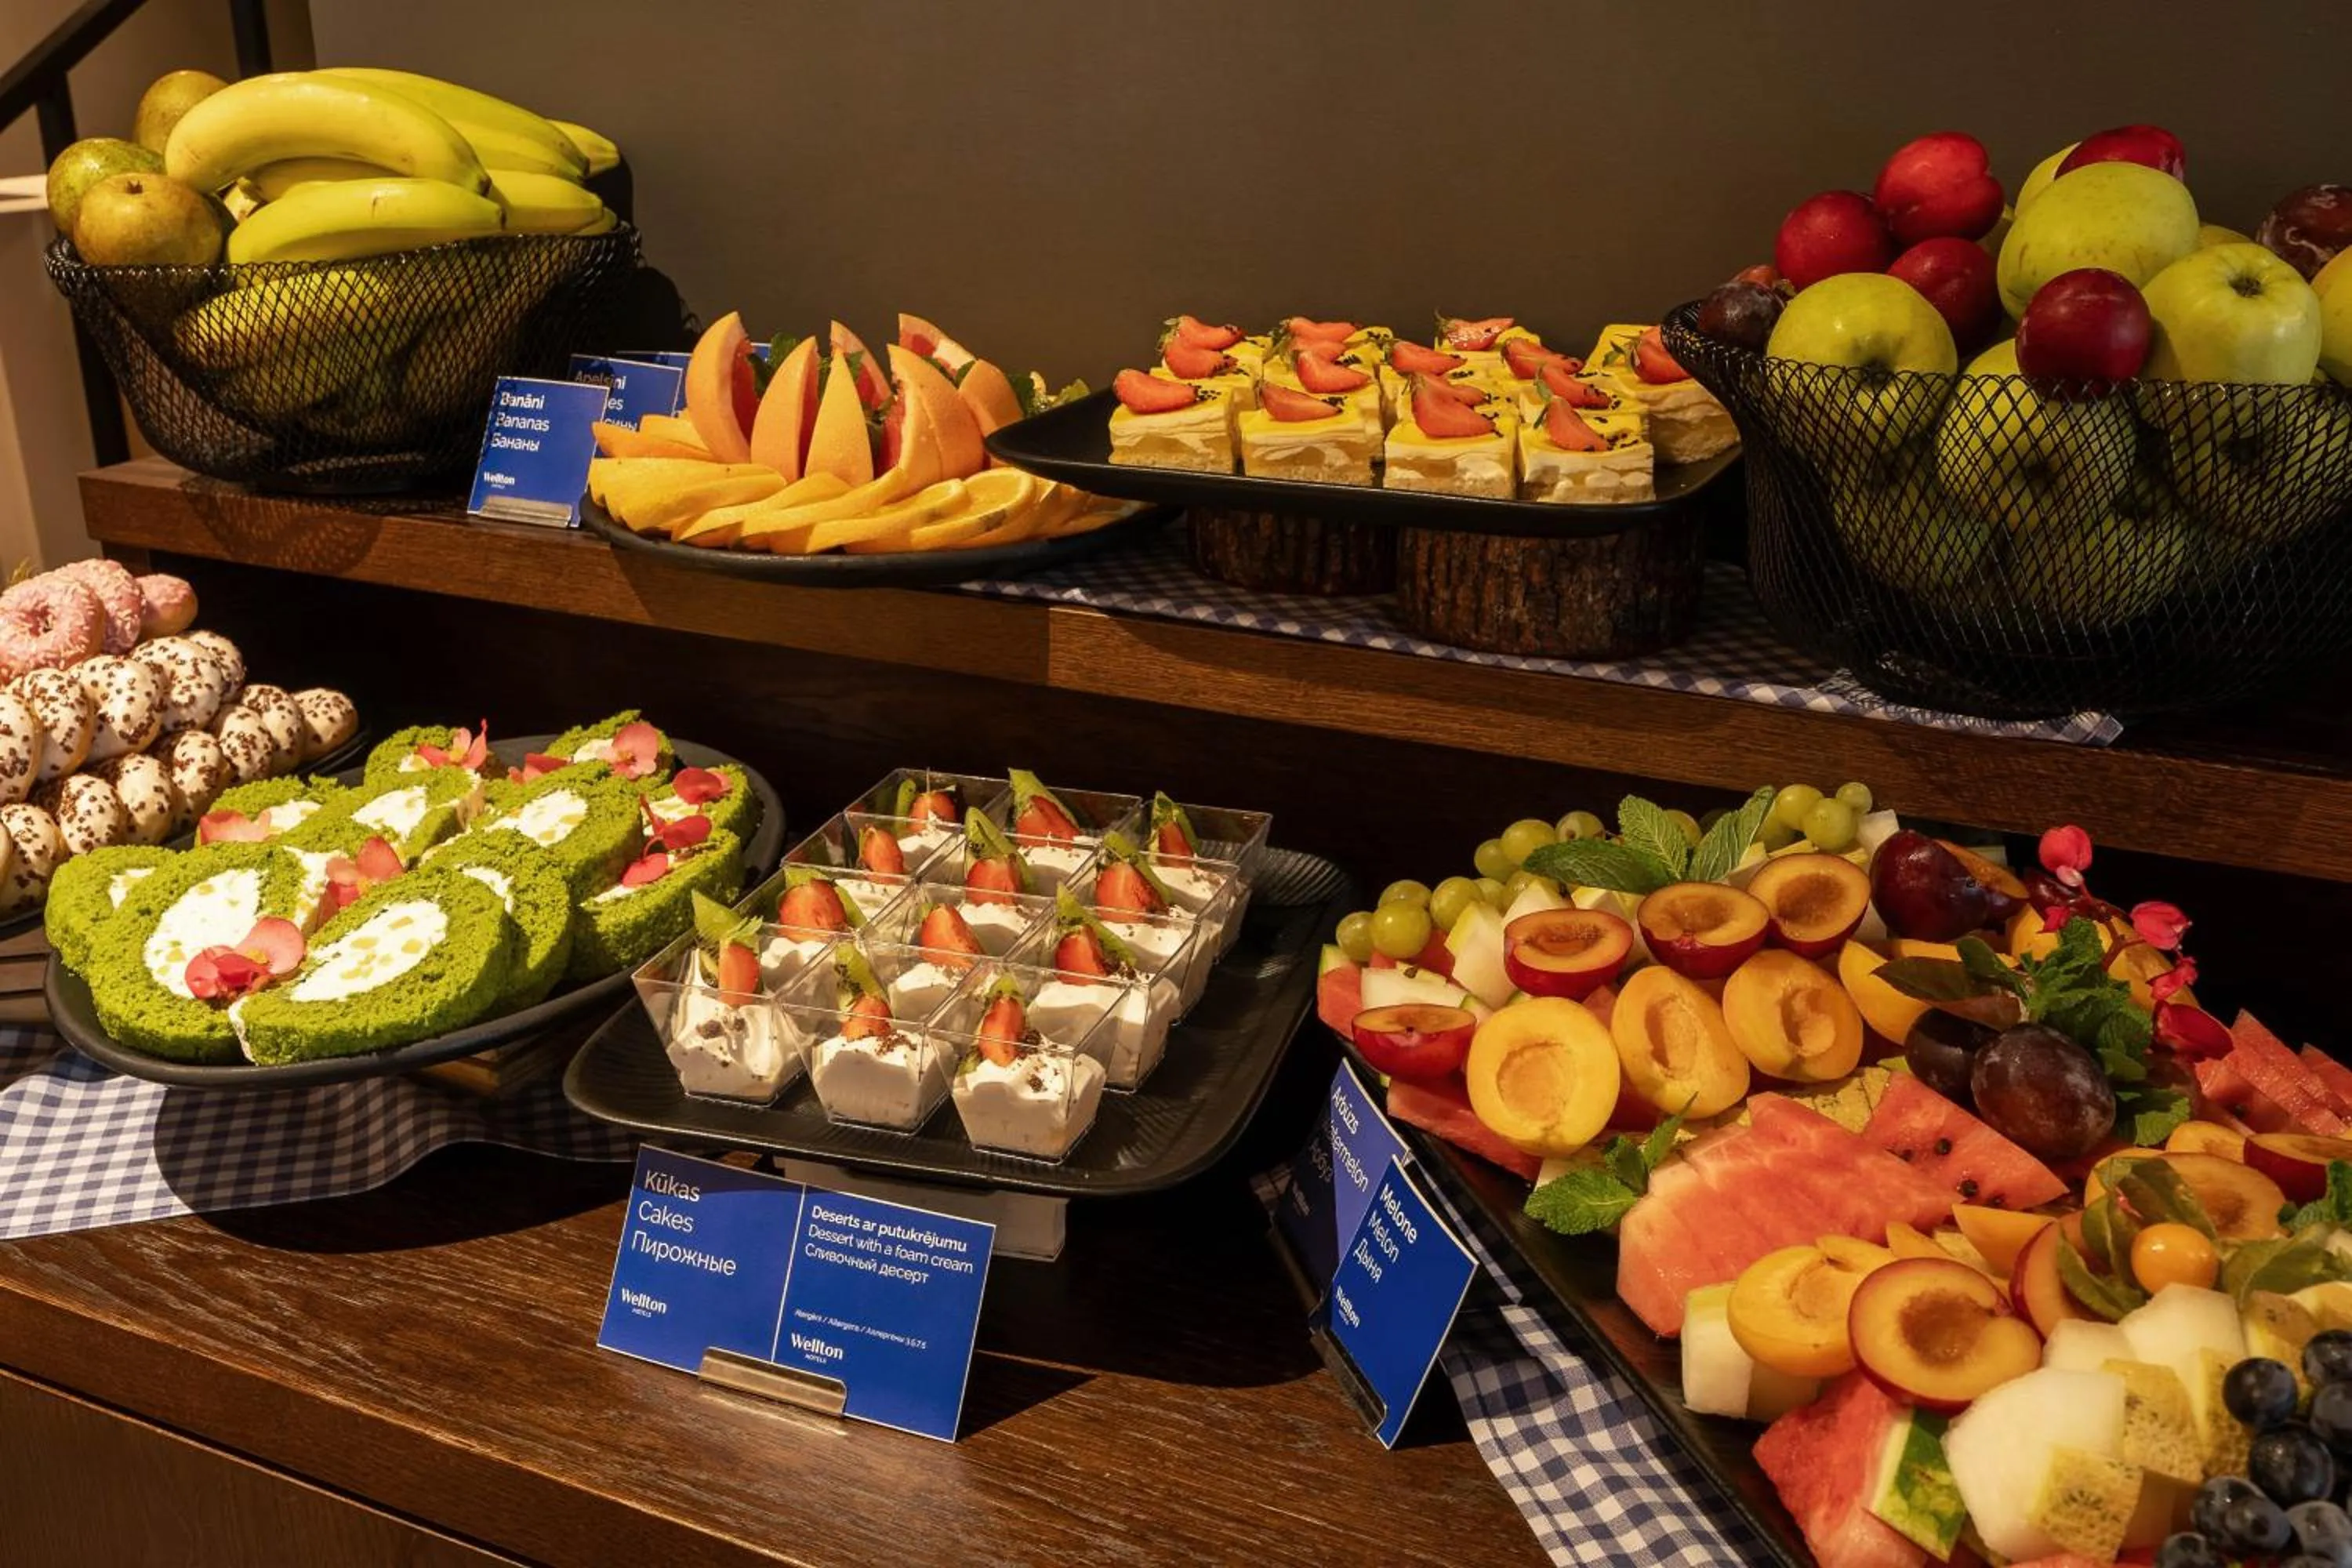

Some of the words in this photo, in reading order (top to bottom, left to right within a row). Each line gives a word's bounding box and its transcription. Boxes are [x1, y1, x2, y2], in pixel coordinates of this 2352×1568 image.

[495, 412, 550, 431] Bananas
[499, 392, 545, 409] Banāni
[491, 432, 539, 452] Бананы
[644, 1170, 700, 1203] Kūkas
[638, 1201, 694, 1233] Cakes
[812, 1206, 860, 1230] Deserts
[862, 1218, 877, 1233] ar
[878, 1225, 967, 1252] putukrējumu
[1380, 1183, 1417, 1244] Melone
[631, 1231, 736, 1276] Пирожные
[808, 1224, 854, 1248] Dessert
[855, 1236, 884, 1254] with
[884, 1247, 893, 1257] a
[895, 1243, 928, 1265] foam
[931, 1256, 973, 1274] cream
[1368, 1210, 1399, 1264] Melon
[805, 1243, 877, 1271] Сливочный
[879, 1262, 929, 1285] десерт
[1352, 1238, 1383, 1283] Дыня
[622, 1287, 666, 1314] Wellton
[1335, 1286, 1360, 1328] Wellton
[790, 1332, 843, 1360] Wellton
